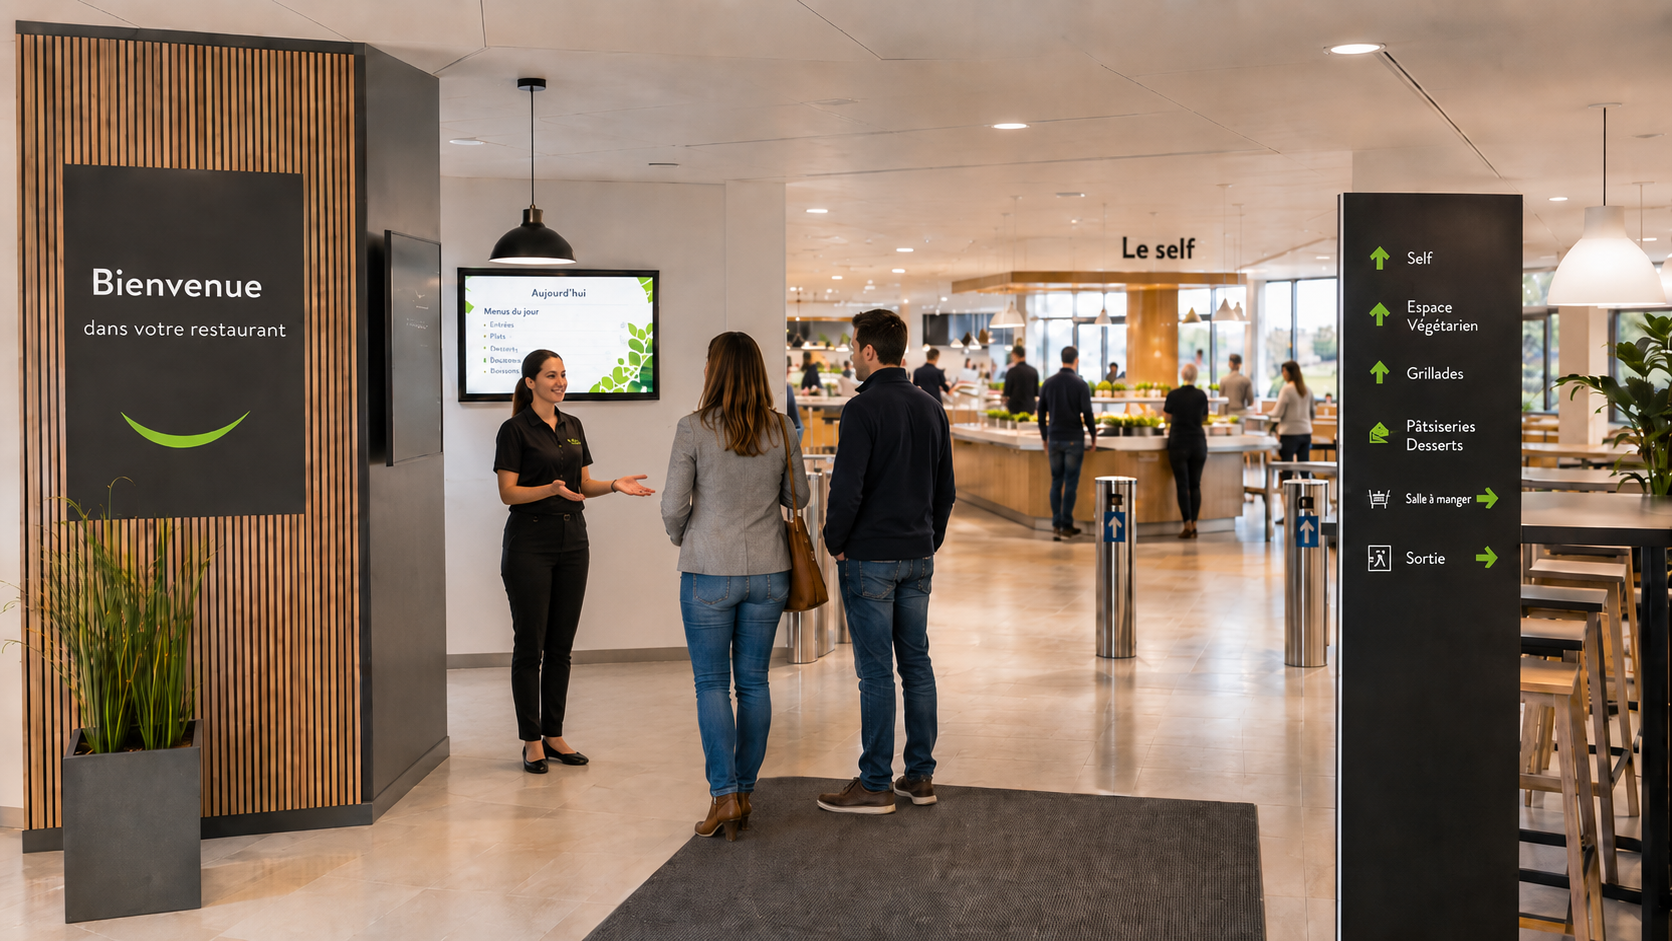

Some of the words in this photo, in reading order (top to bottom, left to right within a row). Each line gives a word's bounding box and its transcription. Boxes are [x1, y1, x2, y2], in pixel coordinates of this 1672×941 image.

[1122, 236, 1149, 260] Le
[1155, 237, 1196, 260] self
[1407, 251, 1434, 265] Self
[92, 268, 263, 299] Bienvenue
[531, 288, 586, 300] Aujourd'hui
[483, 307, 510, 316] Menus
[511, 307, 522, 316] du
[523, 307, 540, 317] jour
[1407, 299, 1453, 317] Espace
[83, 319, 128, 336] dans
[134, 322, 185, 337] votre
[191, 322, 287, 338] restaurant
[489, 320, 515, 329] Entrées
[1406, 318, 1479, 337] Végétarien
[489, 332, 506, 340] Plats
[1406, 366, 1464, 380] Grillades
[1406, 419, 1476, 433] Pâtsiseries
[1406, 437, 1464, 451] Desserts
[1405, 493, 1428, 504] Salle
[1429, 493, 1435, 504] à
[1436, 497, 1472, 508] manger
[1406, 551, 1446, 565] Sortie
